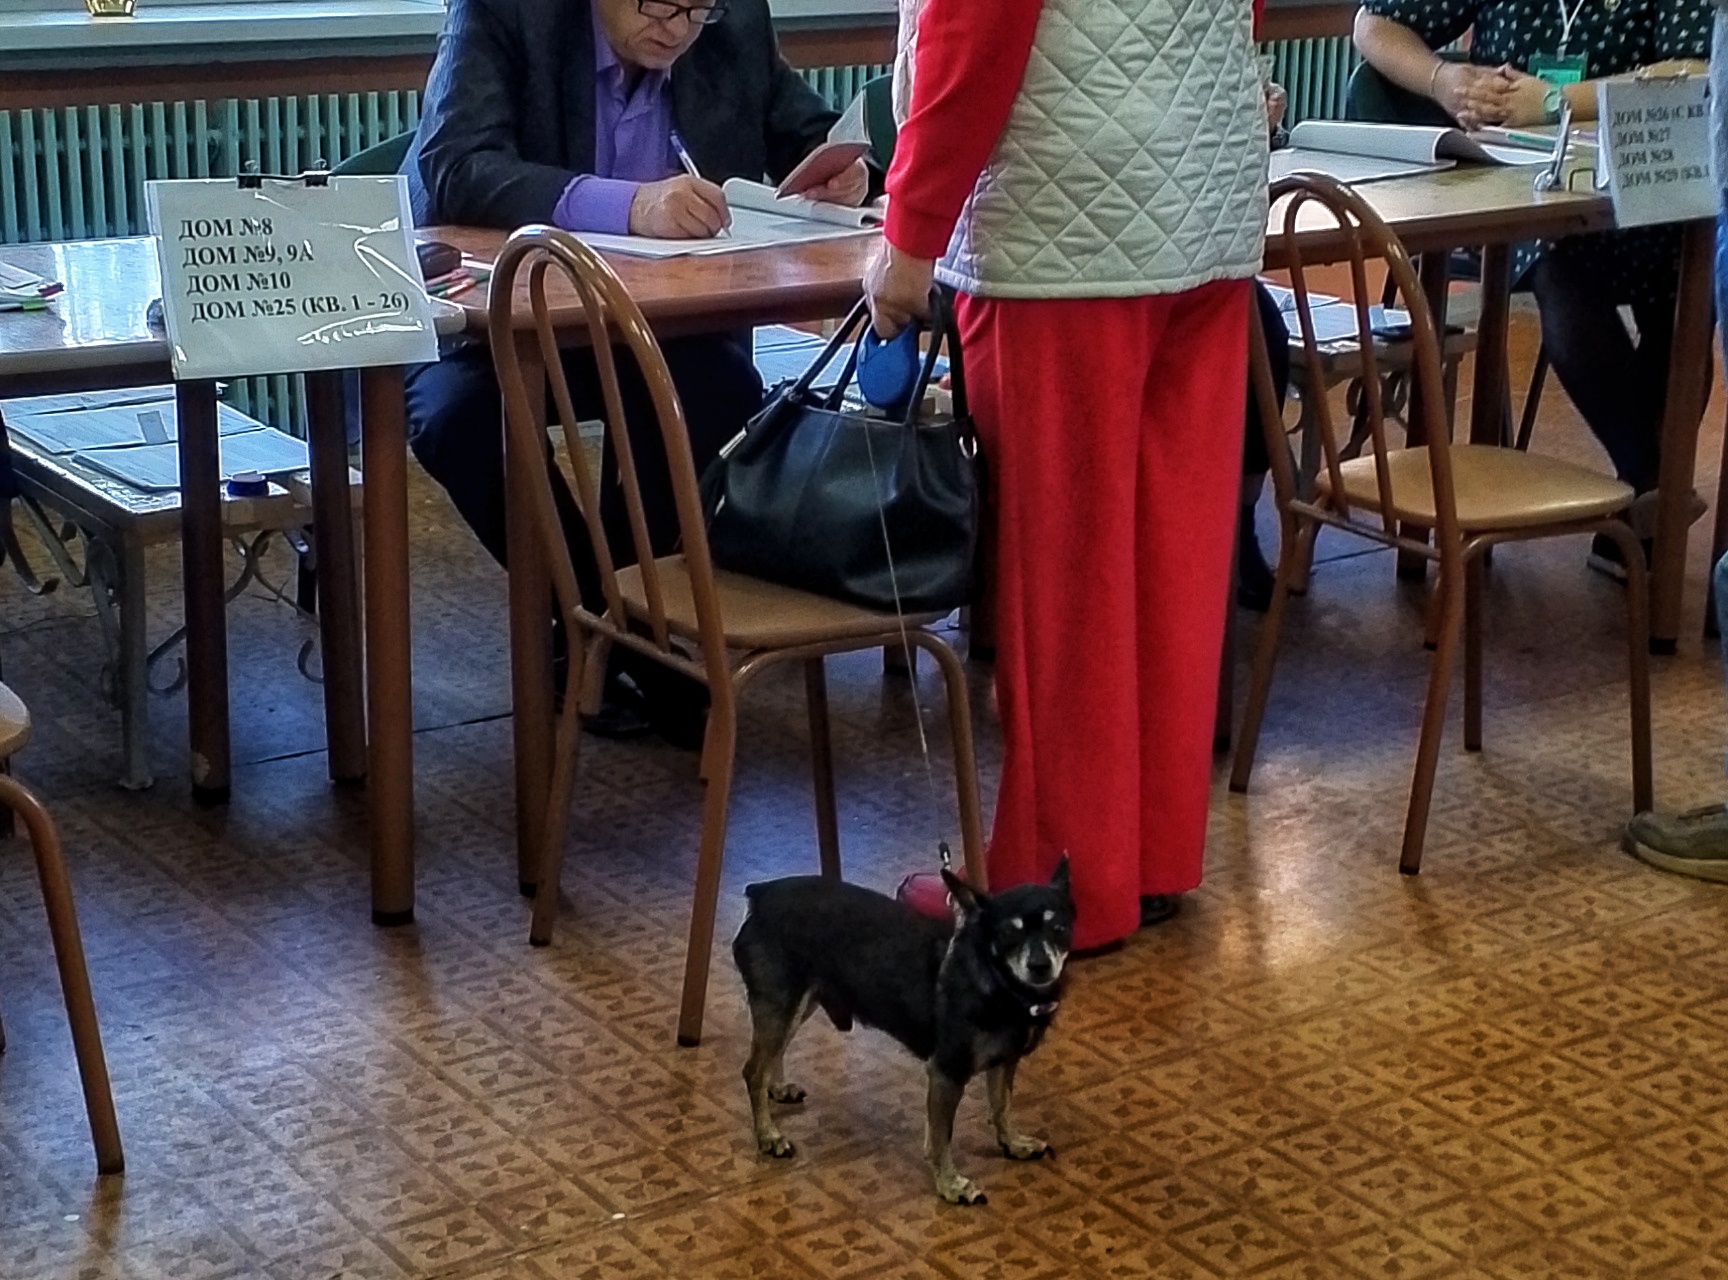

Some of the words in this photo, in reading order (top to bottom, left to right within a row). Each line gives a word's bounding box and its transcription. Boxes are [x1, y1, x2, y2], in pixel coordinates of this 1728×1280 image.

[1613, 107, 1642, 127] ДОМ
[1615, 129, 1644, 148] ДОМ
[1618, 149, 1647, 170] ДОМ
[1622, 170, 1651, 189] ДОМ
[178, 219, 233, 242] ДОМ
[239, 217, 273, 237] №8
[182, 246, 237, 269] ДОМ
[243, 243, 284, 266] №9,
[287, 243, 314, 262] 9А
[186, 274, 241, 297] ДОМ
[246, 271, 291, 290] №10
[191, 301, 246, 324] ДОМ
[251, 298, 297, 317] №25
[302, 295, 347, 318] (КВ.
[352, 294, 361, 312] 1
[382, 292, 410, 312] 26)
